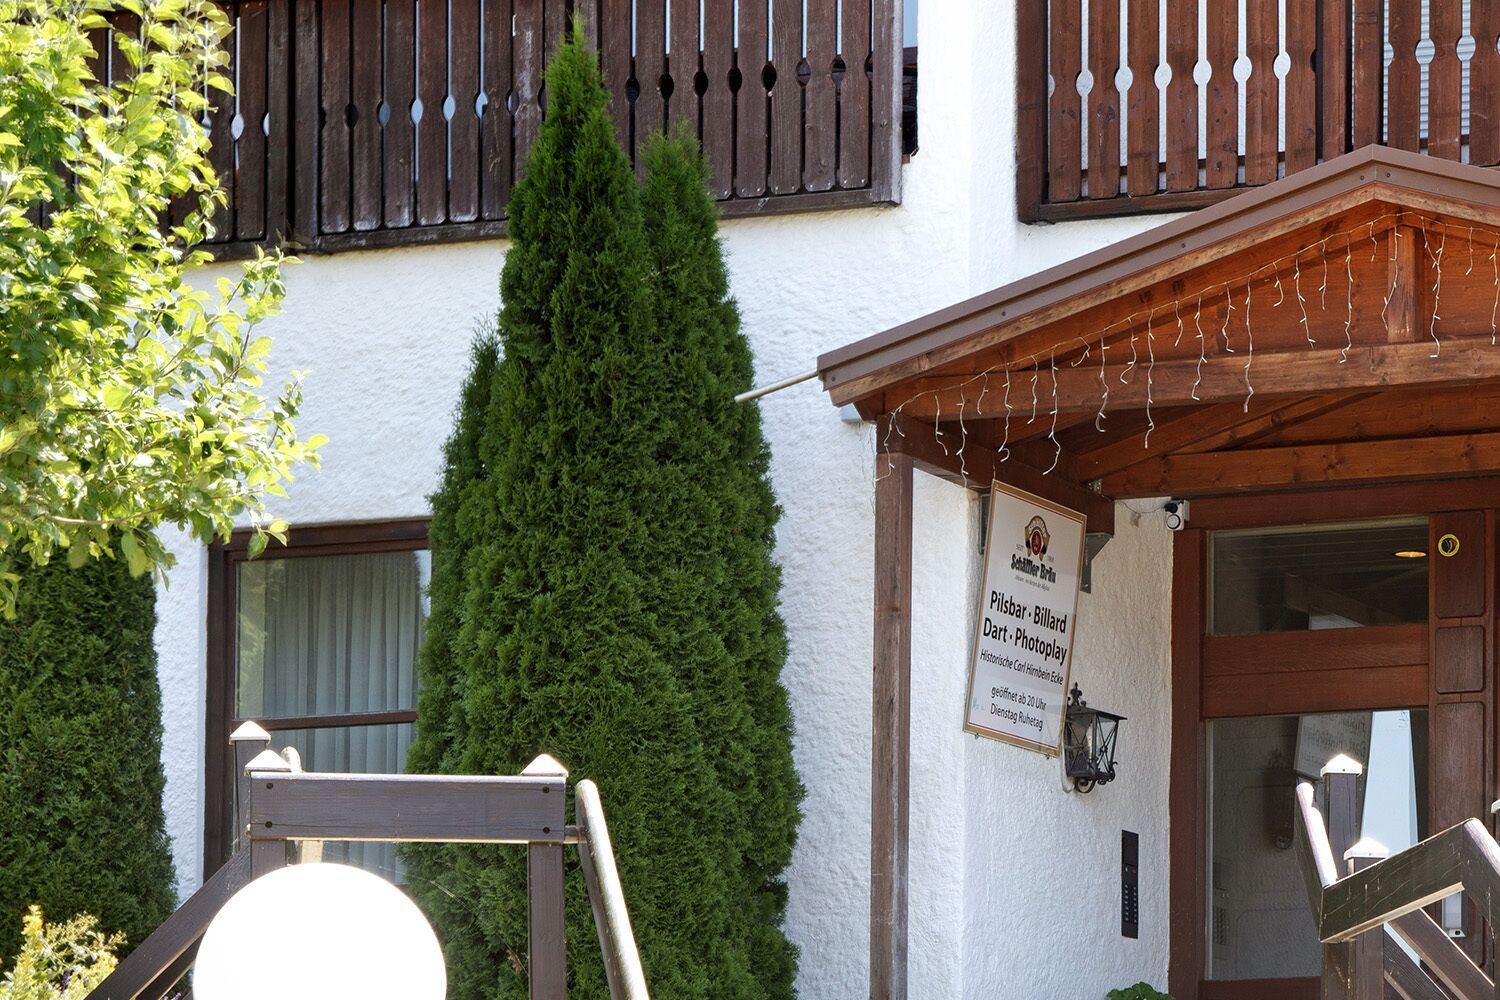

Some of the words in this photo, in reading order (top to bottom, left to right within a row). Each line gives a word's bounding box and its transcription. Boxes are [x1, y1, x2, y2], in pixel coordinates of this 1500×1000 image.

[1039, 563, 1057, 584] Bräu
[990, 590, 1027, 620] Pilsbar
[1033, 605, 1067, 634] Billard
[983, 617, 1008, 643] Dart
[1014, 627, 1068, 666] Photoplay
[980, 648, 1013, 670] Historische
[1013, 659, 1027, 674] Carl
[1025, 663, 1051, 682] Hirnbein
[1050, 671, 1064, 685] Ecke
[991, 686, 1018, 703] geöffnet
[1018, 692, 1027, 705] ab
[1027, 695, 1035, 708] 20
[1035, 697, 1047, 711] Uhr
[990, 702, 1018, 724] Dienstag
[1018, 710, 1043, 732] Ruhetag
